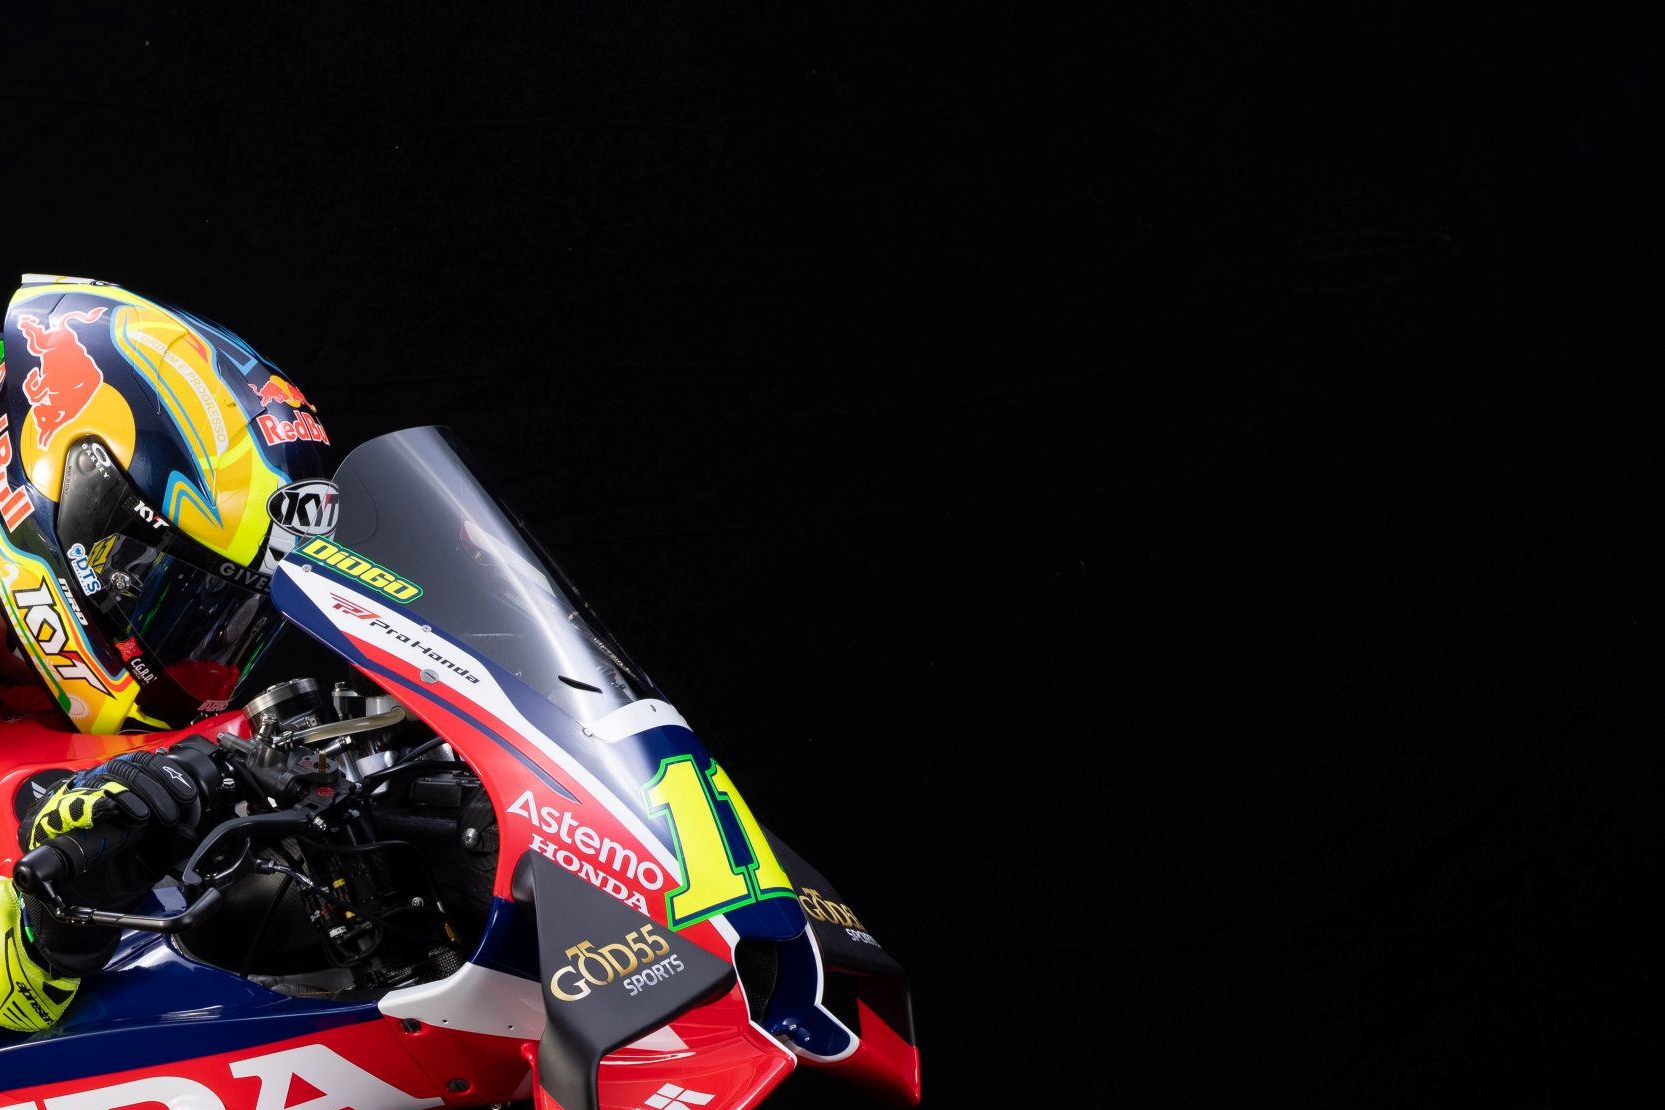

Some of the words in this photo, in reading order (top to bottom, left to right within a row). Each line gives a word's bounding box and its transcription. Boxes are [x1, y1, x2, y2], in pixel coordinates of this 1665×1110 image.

[185, 366, 228, 444] PROGRESSO
[81, 443, 111, 479] OAKLEY
[134, 500, 169, 529] KYT
[75, 556, 102, 593] DTS
[505, 790, 664, 892] Astemo
[641, 753, 797, 931] 11
[528, 833, 651, 918] HONDA
[622, 953, 685, 997] SPORTS
